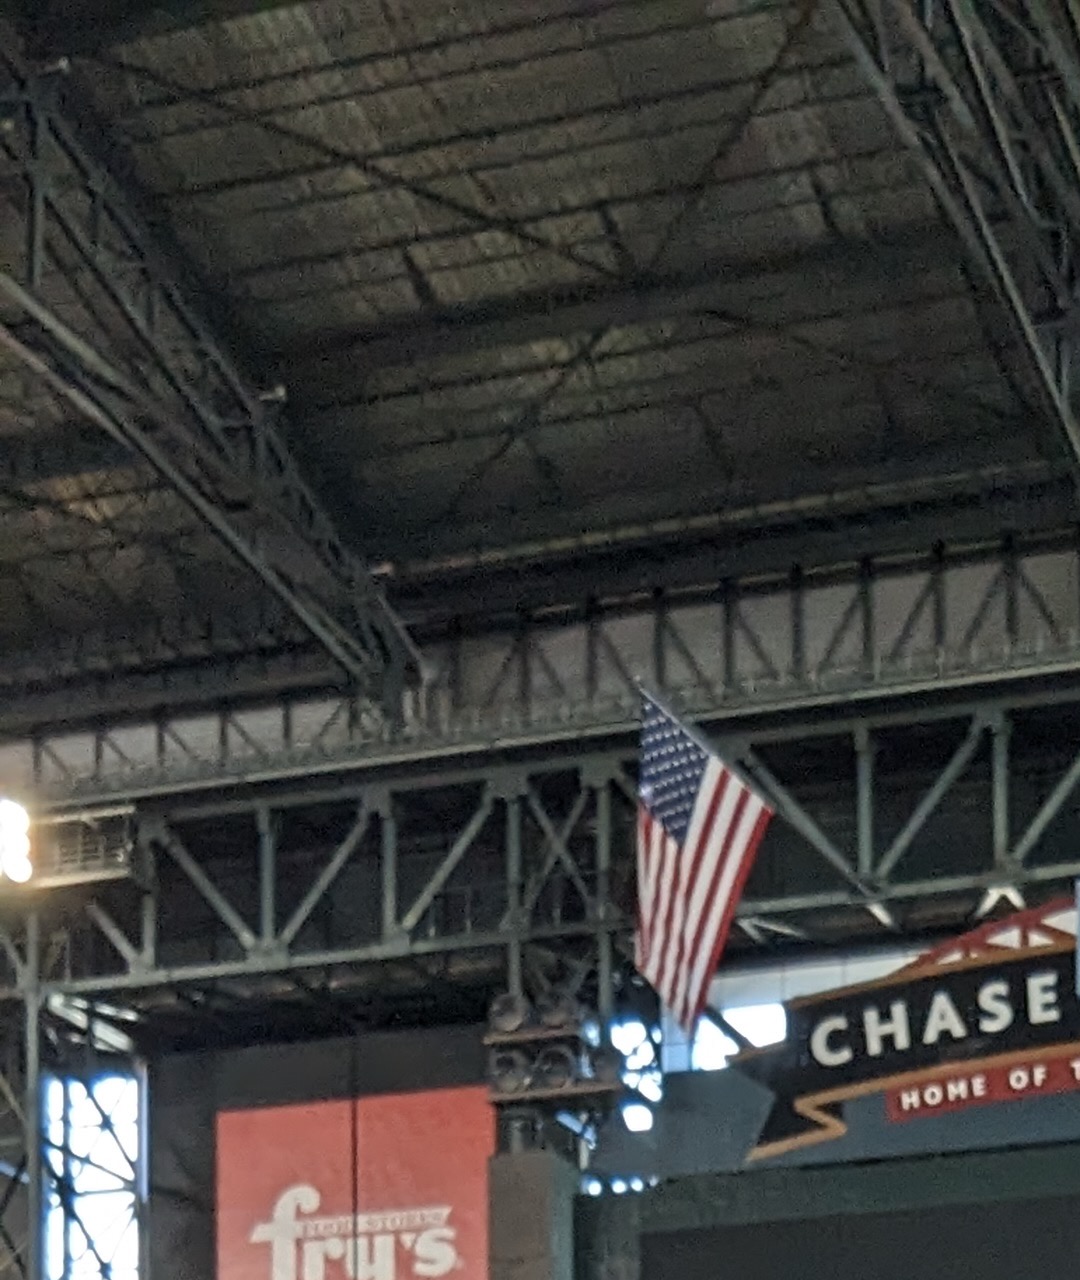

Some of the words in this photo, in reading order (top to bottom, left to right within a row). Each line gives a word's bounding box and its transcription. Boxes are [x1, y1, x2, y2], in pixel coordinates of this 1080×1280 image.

[810, 971, 1061, 1067] CHASE
[901, 1074, 987, 1111] HOME
[1008, 1064, 1047, 1091] OF
